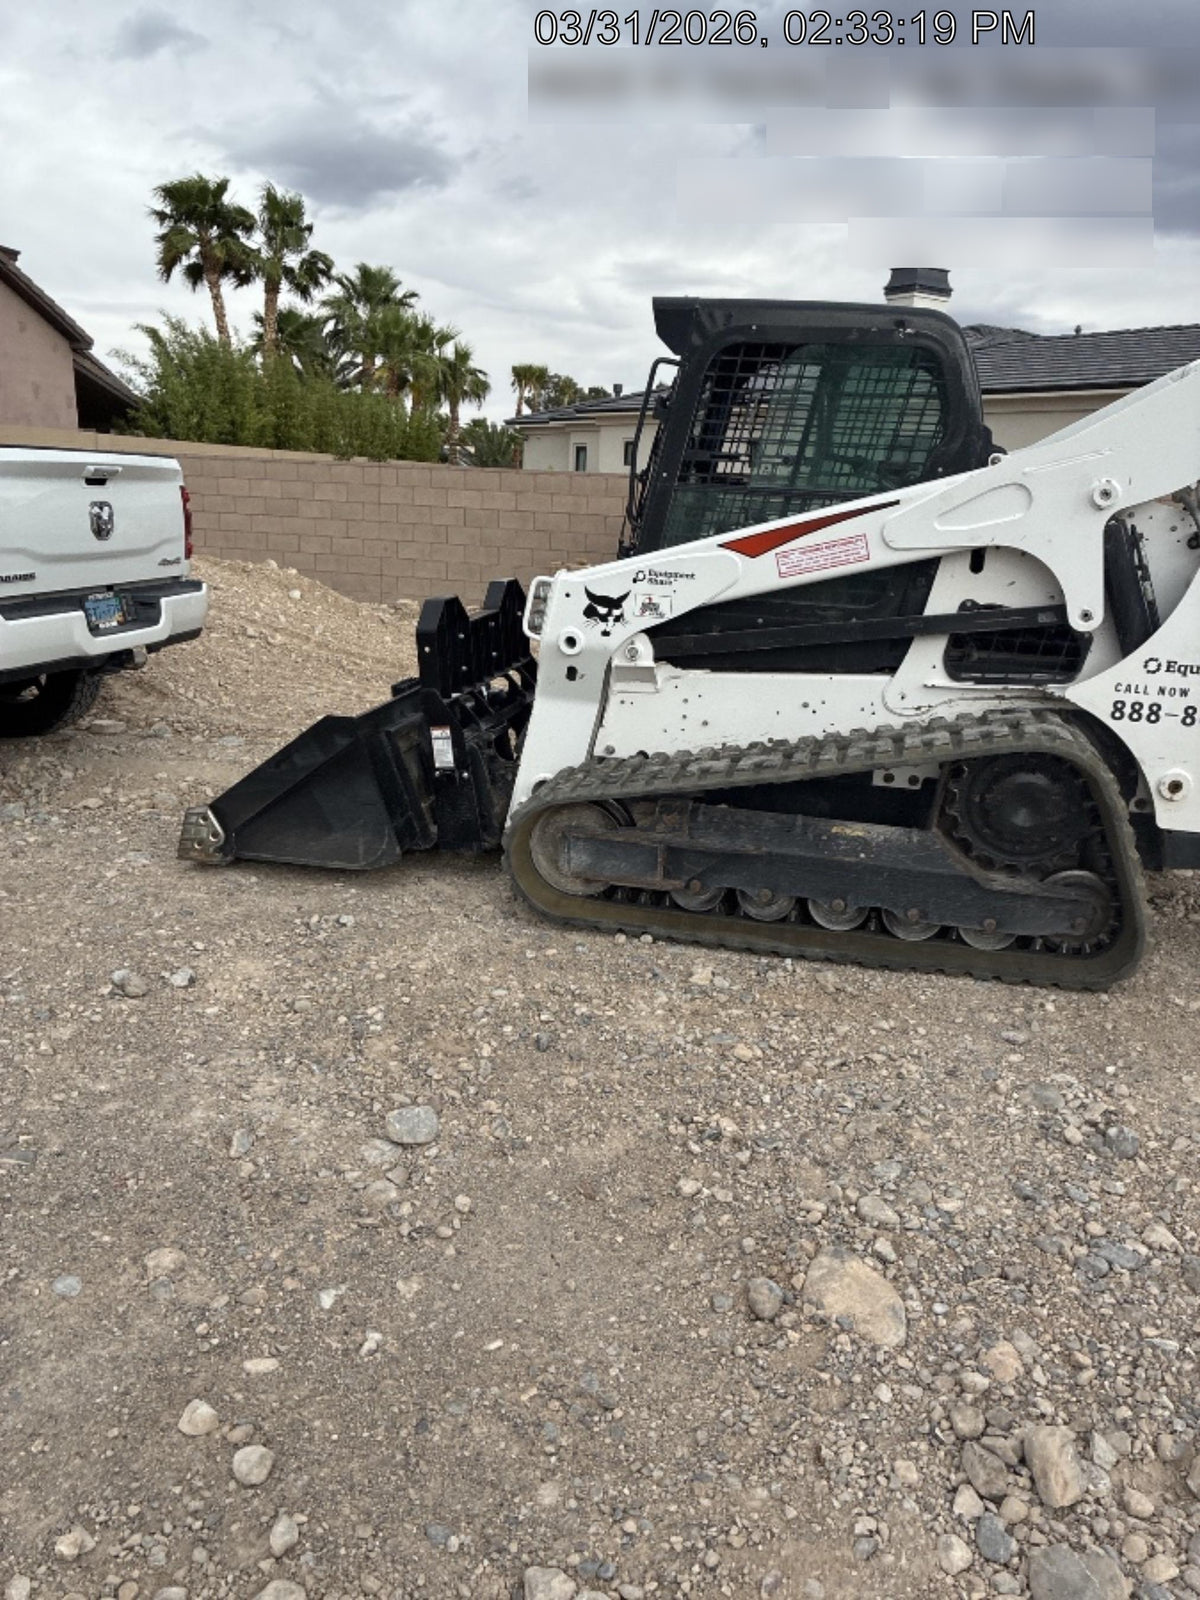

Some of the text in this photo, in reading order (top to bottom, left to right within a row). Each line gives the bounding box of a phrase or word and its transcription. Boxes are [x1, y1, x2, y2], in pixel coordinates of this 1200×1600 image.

[1164, 660, 1200, 677] Equ
[1114, 682, 1190, 698] CALL NOW
